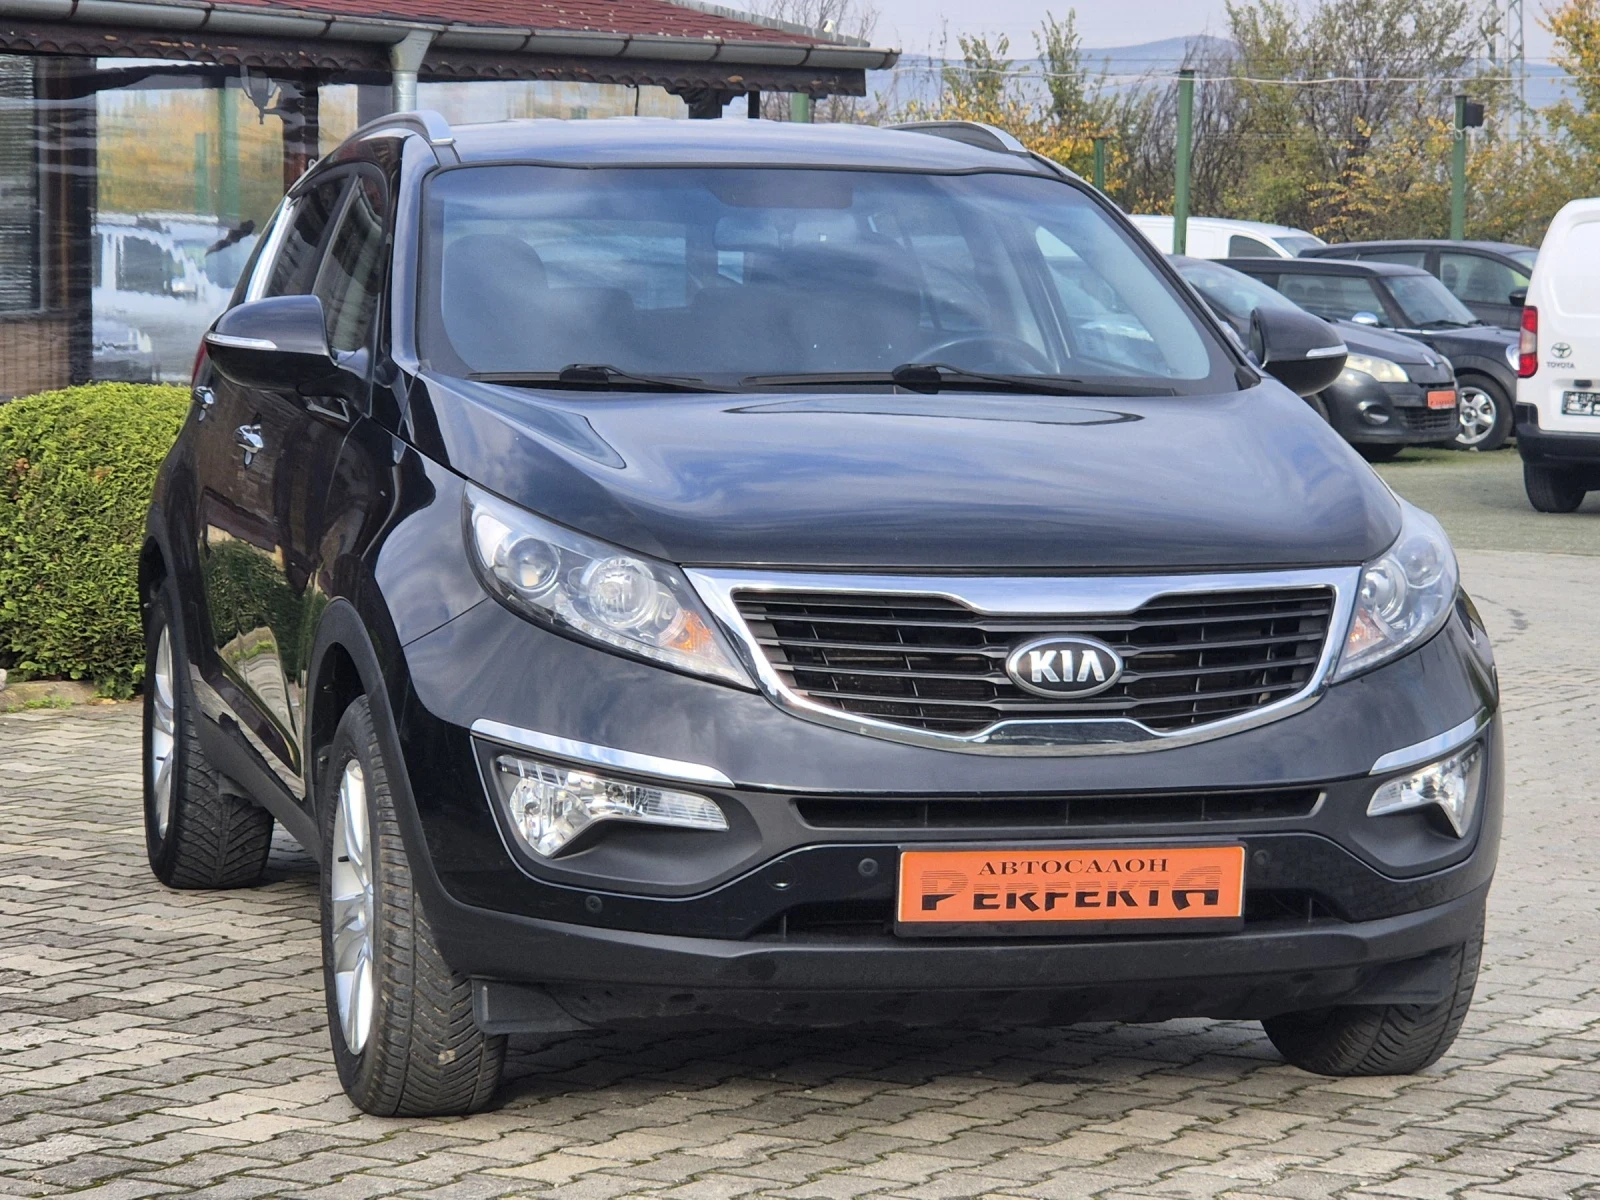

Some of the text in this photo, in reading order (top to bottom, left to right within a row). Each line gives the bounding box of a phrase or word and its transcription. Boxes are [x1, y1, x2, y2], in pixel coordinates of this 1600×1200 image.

[1546, 361, 1576, 369] TOYOTA
[1028, 649, 1106, 683] KIA
[977, 857, 1170, 876] АВТОСАЛОН
